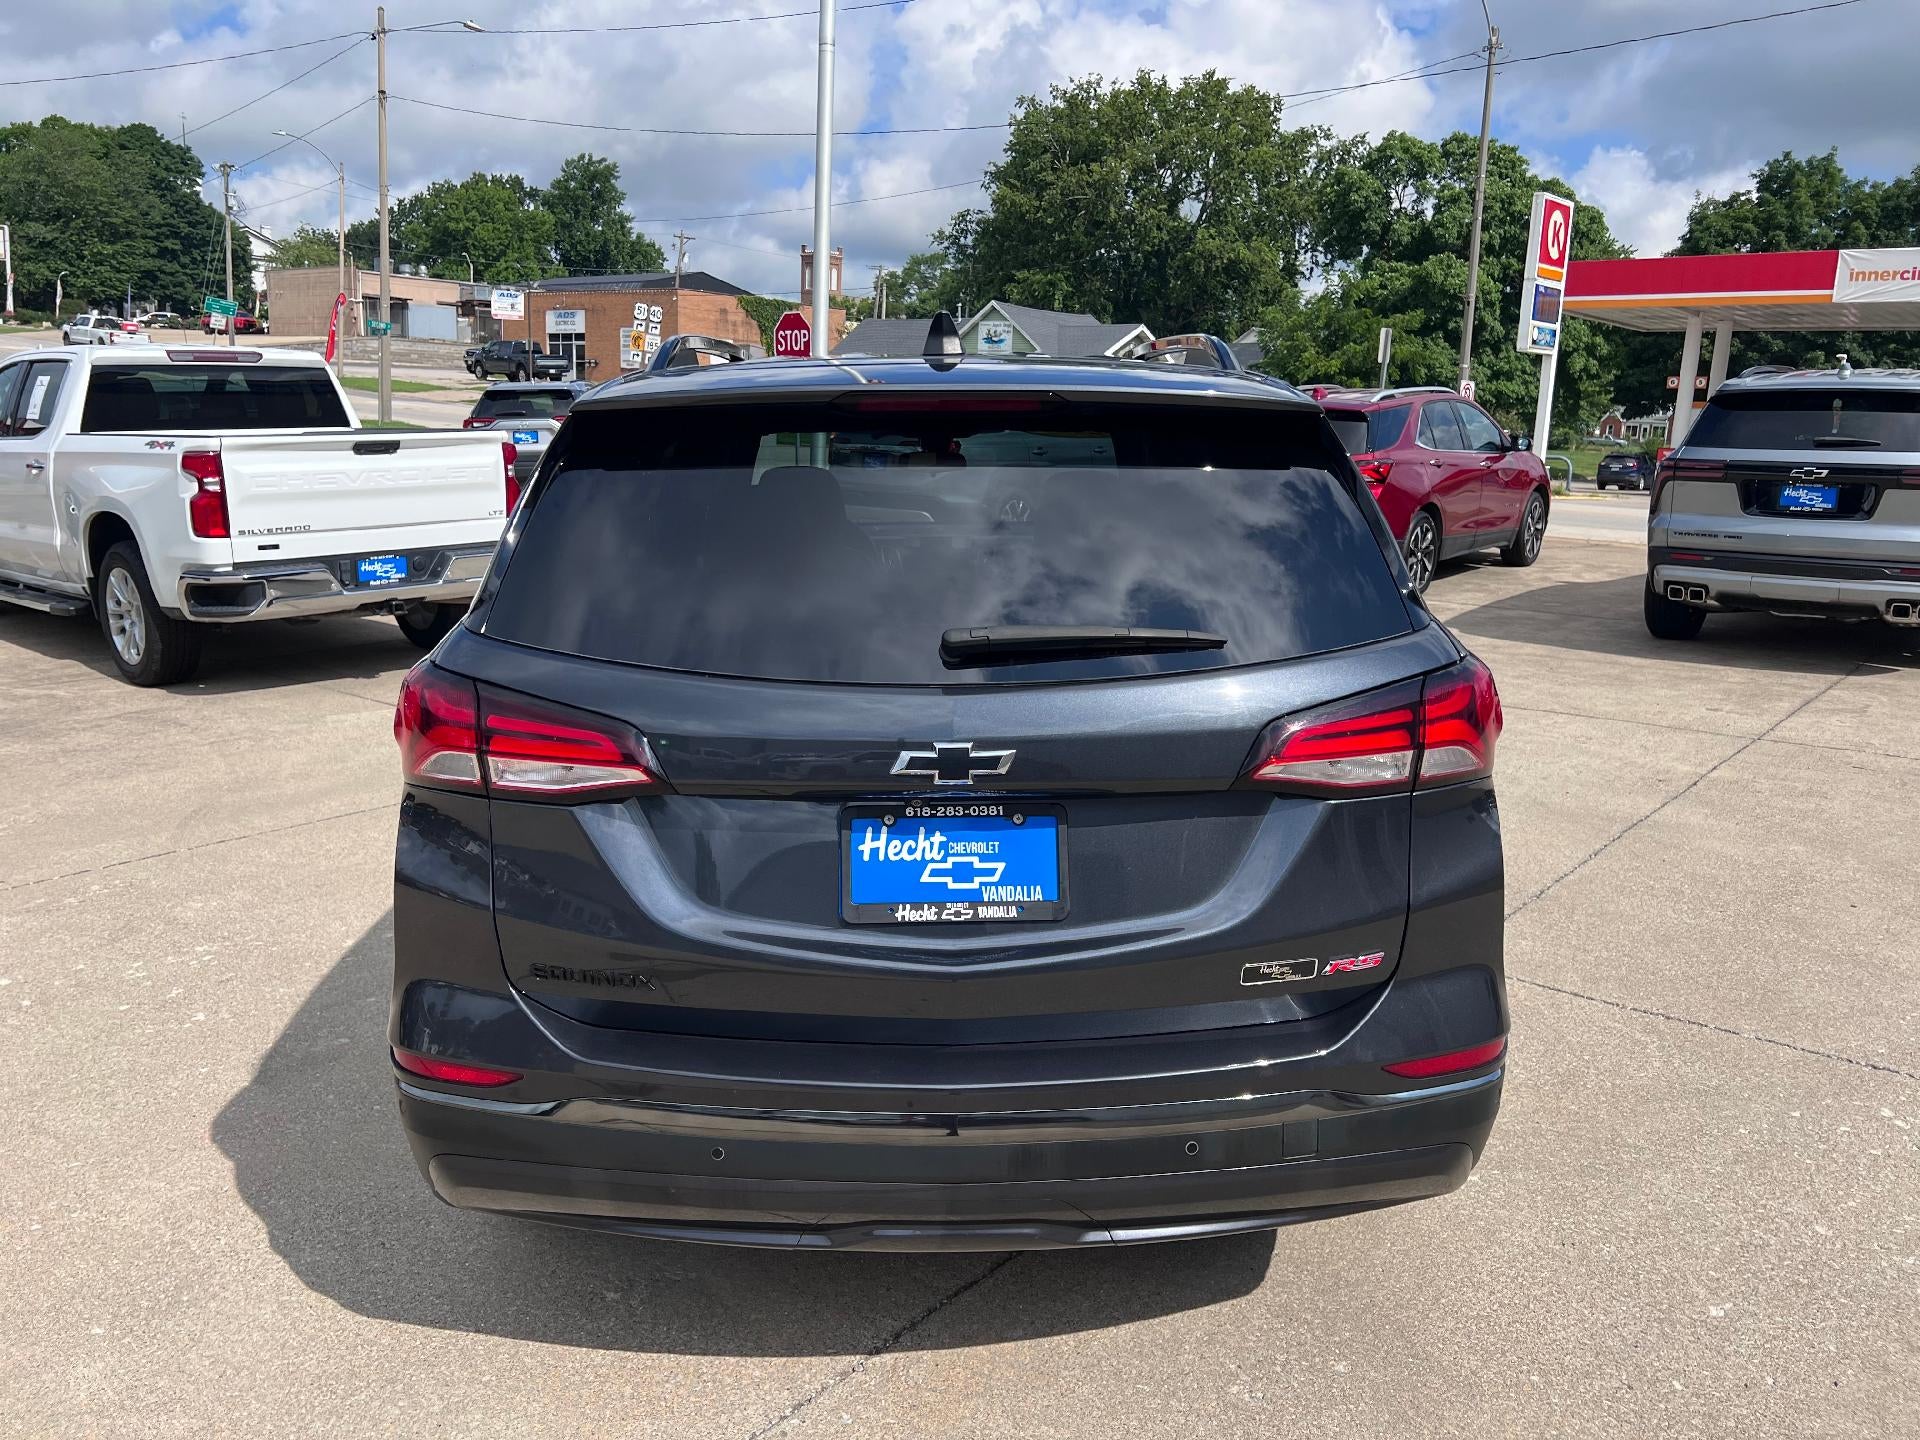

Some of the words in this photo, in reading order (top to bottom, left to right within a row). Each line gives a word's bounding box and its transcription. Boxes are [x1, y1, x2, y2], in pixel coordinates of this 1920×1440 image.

[557, 311, 576, 319] ADS
[636, 306, 645, 316] 51
[650, 309, 662, 319] 40
[777, 329, 809, 351] STOP
[250, 465, 491, 491] CHEVROLET
[1784, 487, 1808, 497] Hecht
[238, 525, 311, 535] SILVERADO
[905, 805, 1004, 817] 618-283-0381
[858, 826, 947, 862] Hecht
[948, 841, 1000, 854] CHEVROLET
[981, 885, 1043, 902] VANDALIA
[895, 903, 939, 922] Hecht
[977, 905, 1018, 919] VANDALIA
[1321, 951, 1385, 976] RS
